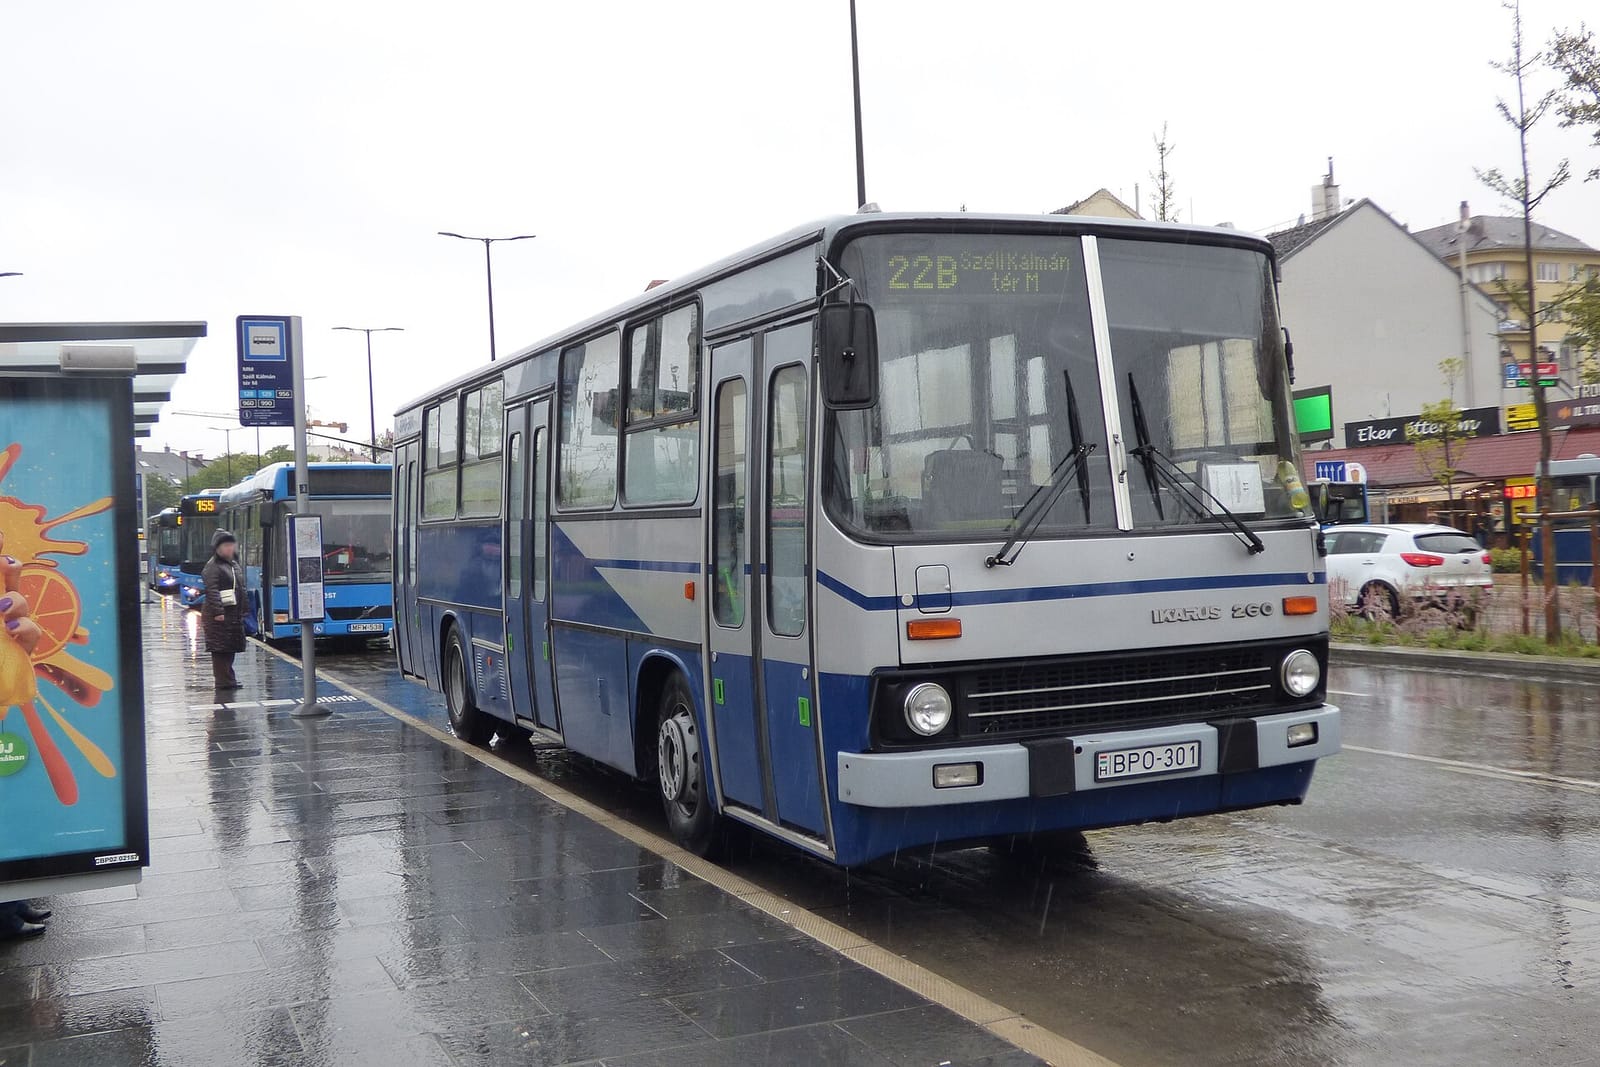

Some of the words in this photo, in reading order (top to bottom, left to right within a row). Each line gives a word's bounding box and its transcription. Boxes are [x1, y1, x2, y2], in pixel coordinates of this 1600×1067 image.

[888, 255, 958, 289] 22B
[1007, 249, 1069, 272] Kálmán
[991, 271, 1020, 292] tér
[1025, 272, 1039, 292] M
[1357, 425, 1398, 442] Eker
[196, 500, 214, 512] 155
[1152, 606, 1222, 624] IKARUS
[1231, 602, 1275, 619] 260
[1098, 766, 1109, 777] H
[1112, 745, 1198, 774] BPO-301
